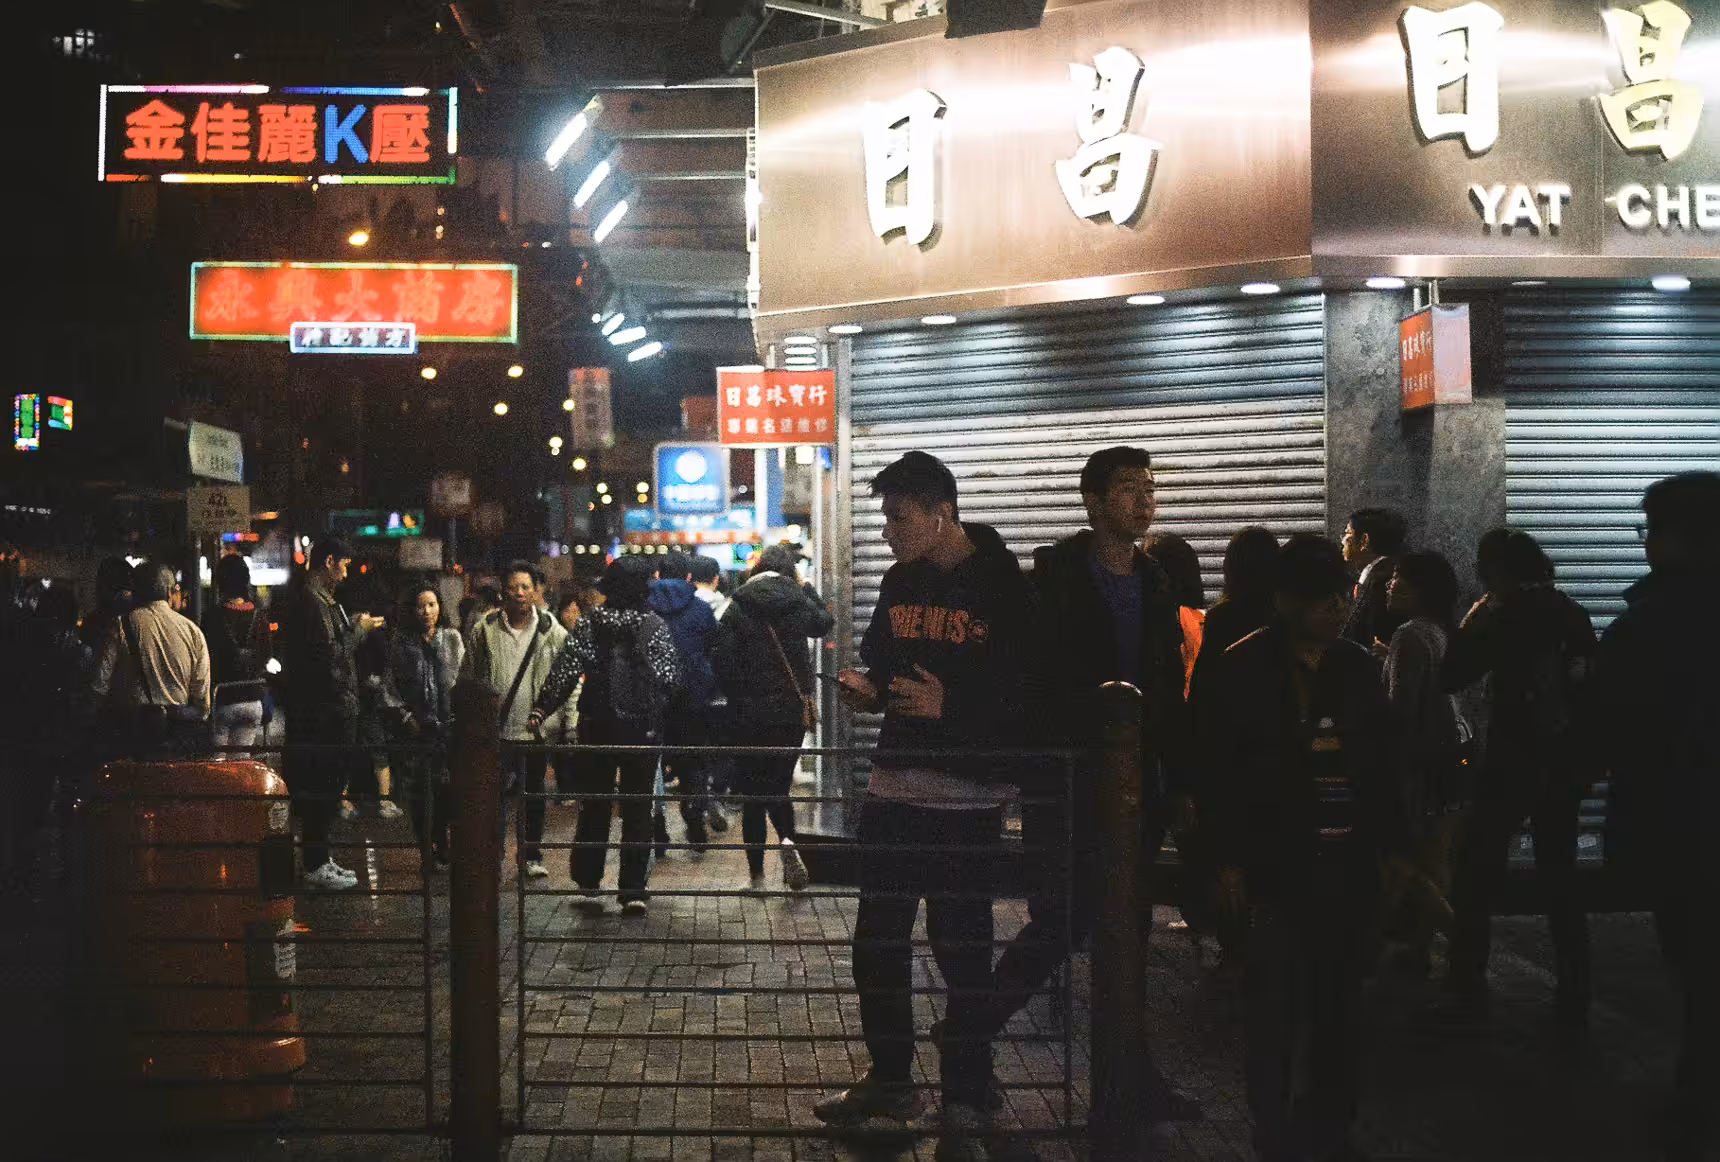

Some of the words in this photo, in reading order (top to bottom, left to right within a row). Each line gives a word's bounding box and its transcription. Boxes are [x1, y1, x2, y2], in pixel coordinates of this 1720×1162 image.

[124, 99, 431, 164] 金佳麗K壓
[863, 46, 1165, 248] 日昌
[1471, 184, 1571, 227] YAT
[1616, 184, 1720, 228] CHE
